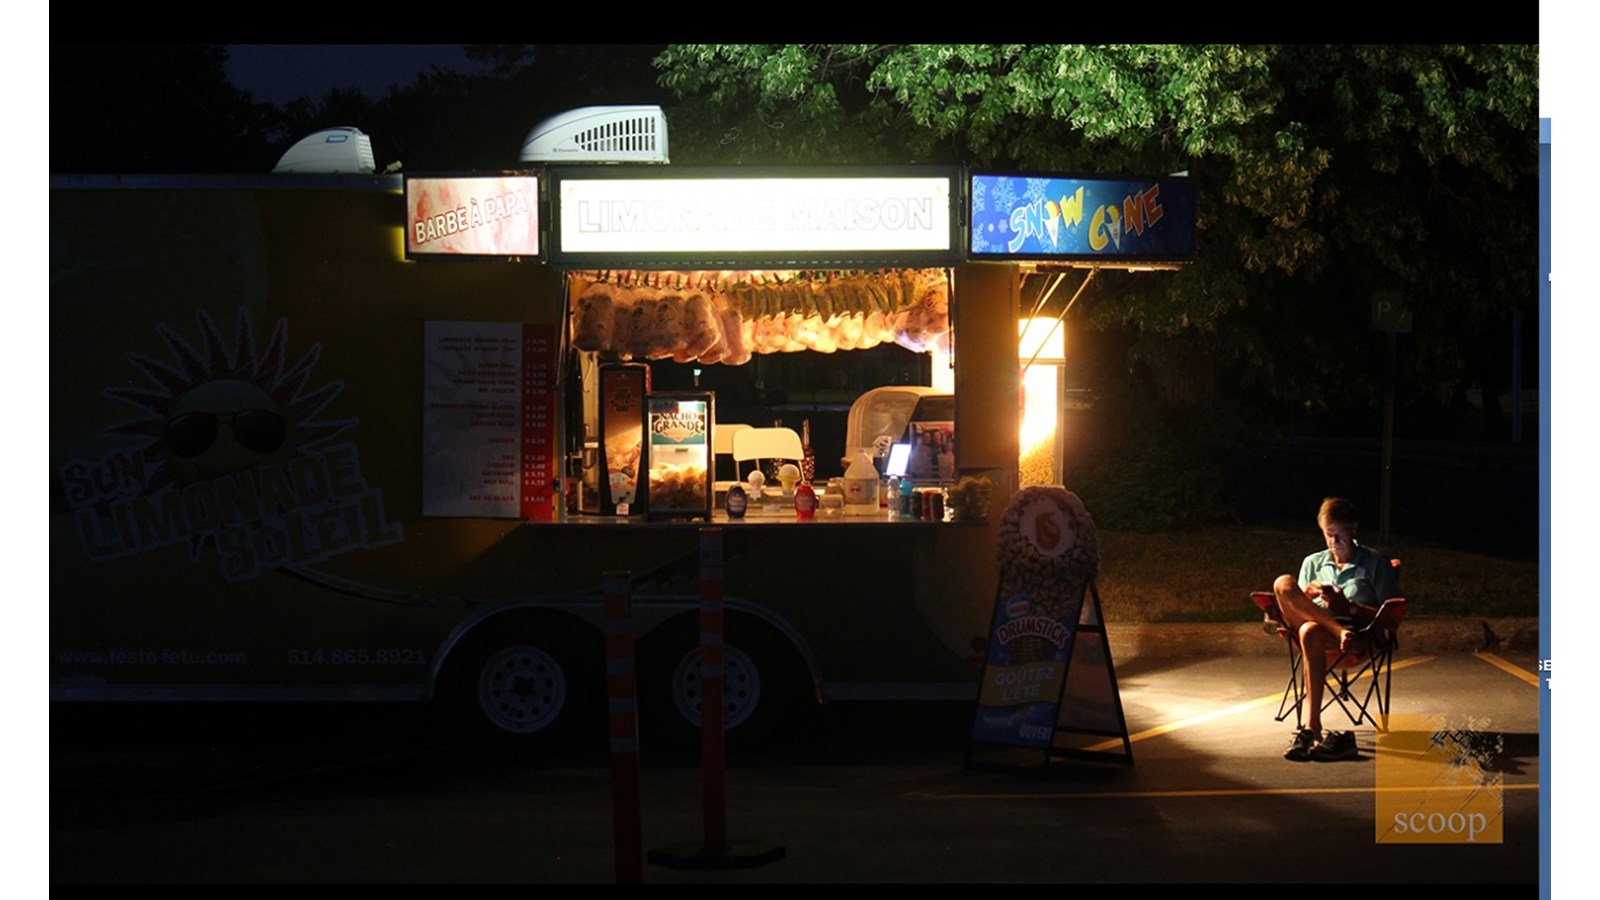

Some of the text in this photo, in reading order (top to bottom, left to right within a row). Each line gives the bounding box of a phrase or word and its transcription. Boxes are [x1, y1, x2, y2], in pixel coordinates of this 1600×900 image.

[415, 189, 529, 245] BARBE À PAPA
[578, 197, 933, 234] LIMONADE MAISON
[655, 420, 702, 434] GRANDE
[659, 410, 697, 421] NACHO
[60, 448, 146, 507] SUN
[76, 442, 367, 562] LIMONADE
[214, 487, 404, 583] SOLEIL
[997, 616, 1070, 649] DRUMSTICK
[286, 648, 426, 665] 514.865.8921
